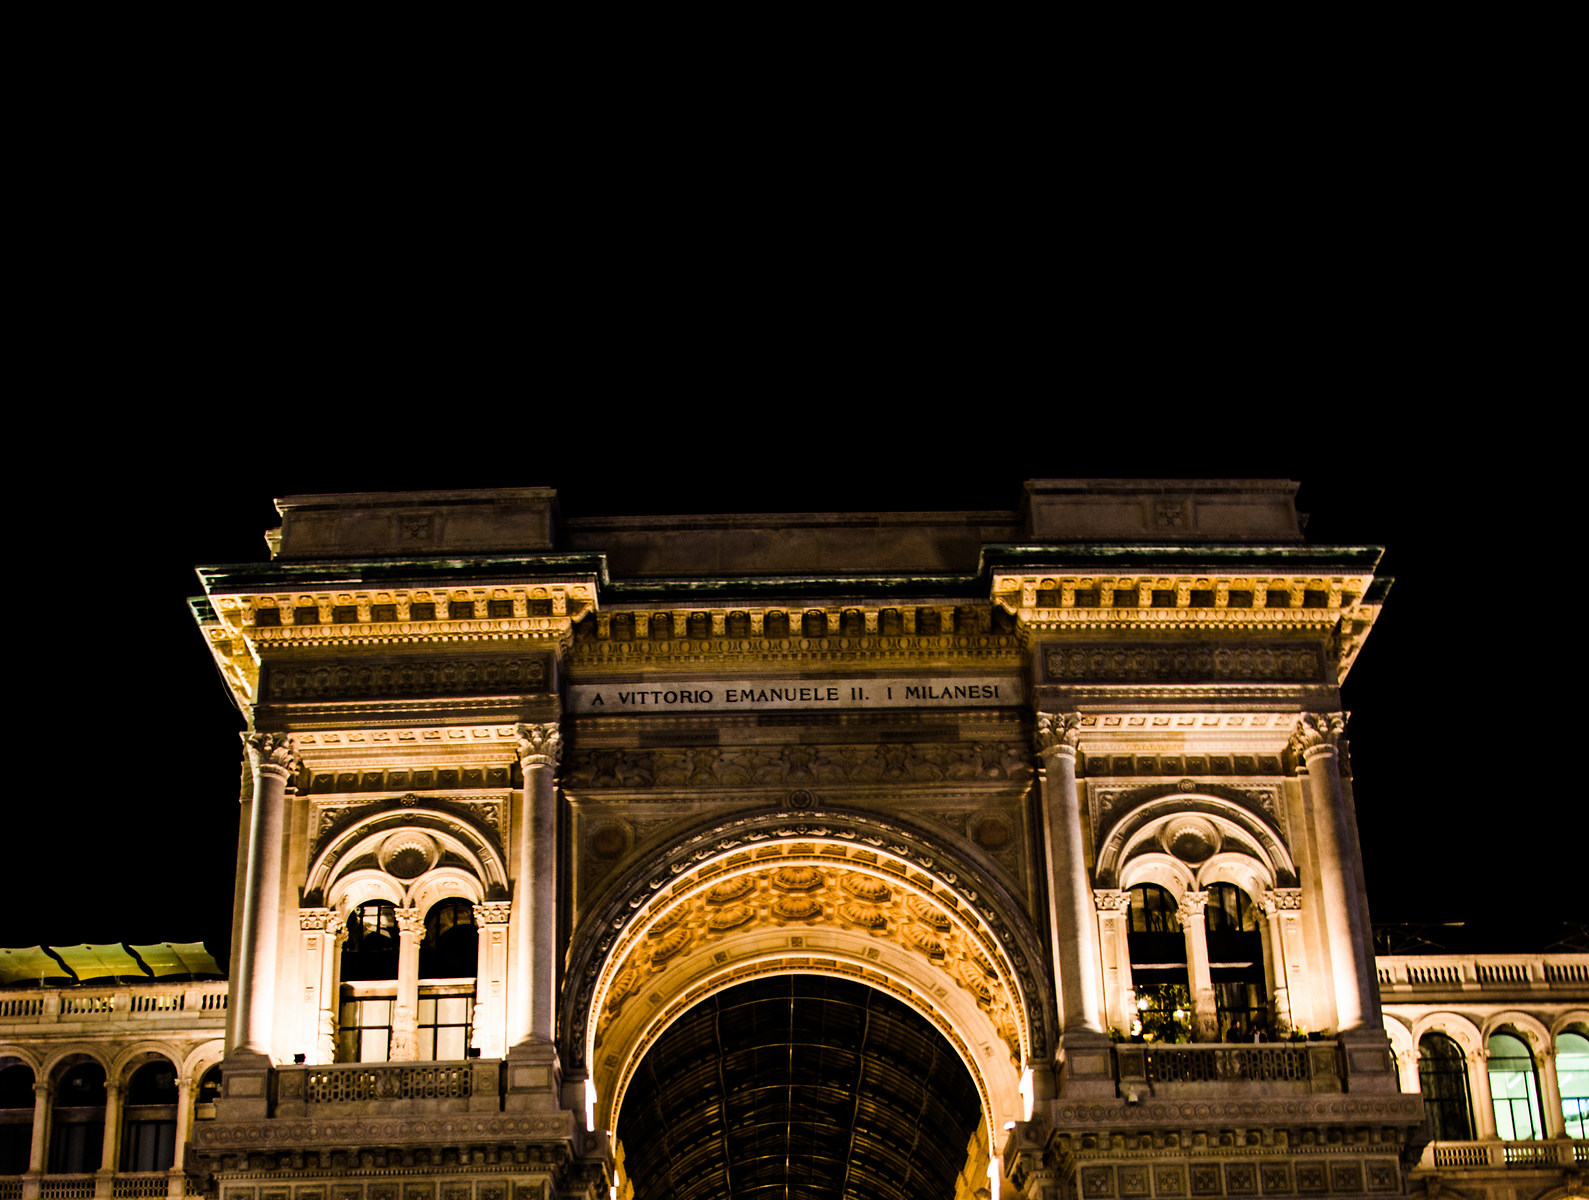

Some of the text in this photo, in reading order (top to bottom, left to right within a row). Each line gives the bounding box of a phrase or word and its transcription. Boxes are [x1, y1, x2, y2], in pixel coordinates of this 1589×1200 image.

[592, 685, 999, 706] A VITTORIO EMANUELE II. I MILANESI
